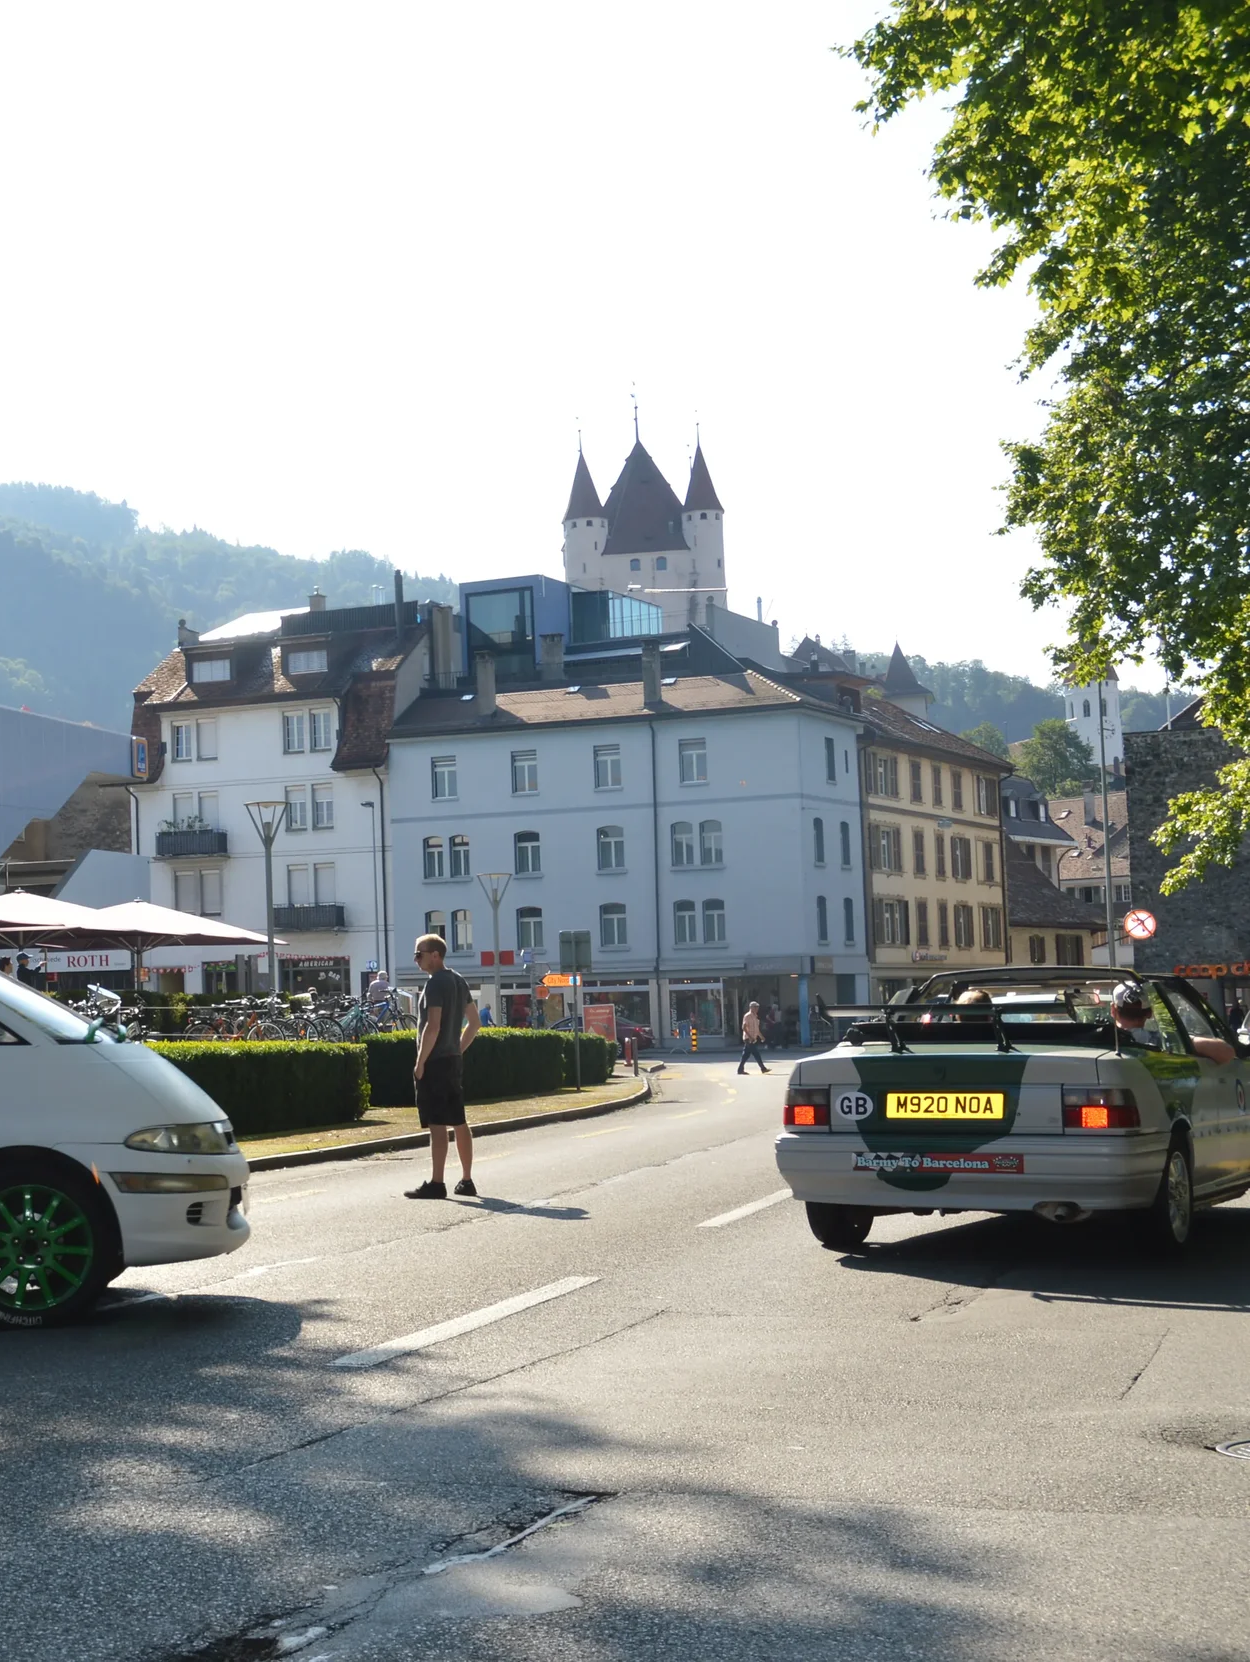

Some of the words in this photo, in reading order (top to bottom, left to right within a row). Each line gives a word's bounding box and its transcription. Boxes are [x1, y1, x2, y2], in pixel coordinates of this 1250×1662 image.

[67, 954, 109, 968] ROTH
[1173, 964, 1228, 979] coop
[840, 1096, 868, 1115] GB
[896, 1096, 948, 1114] M920
[955, 1096, 994, 1114] NOA
[857, 1156, 899, 1169] Barmy
[901, 1157, 920, 1168] To
[922, 1157, 990, 1169] Barcelona
